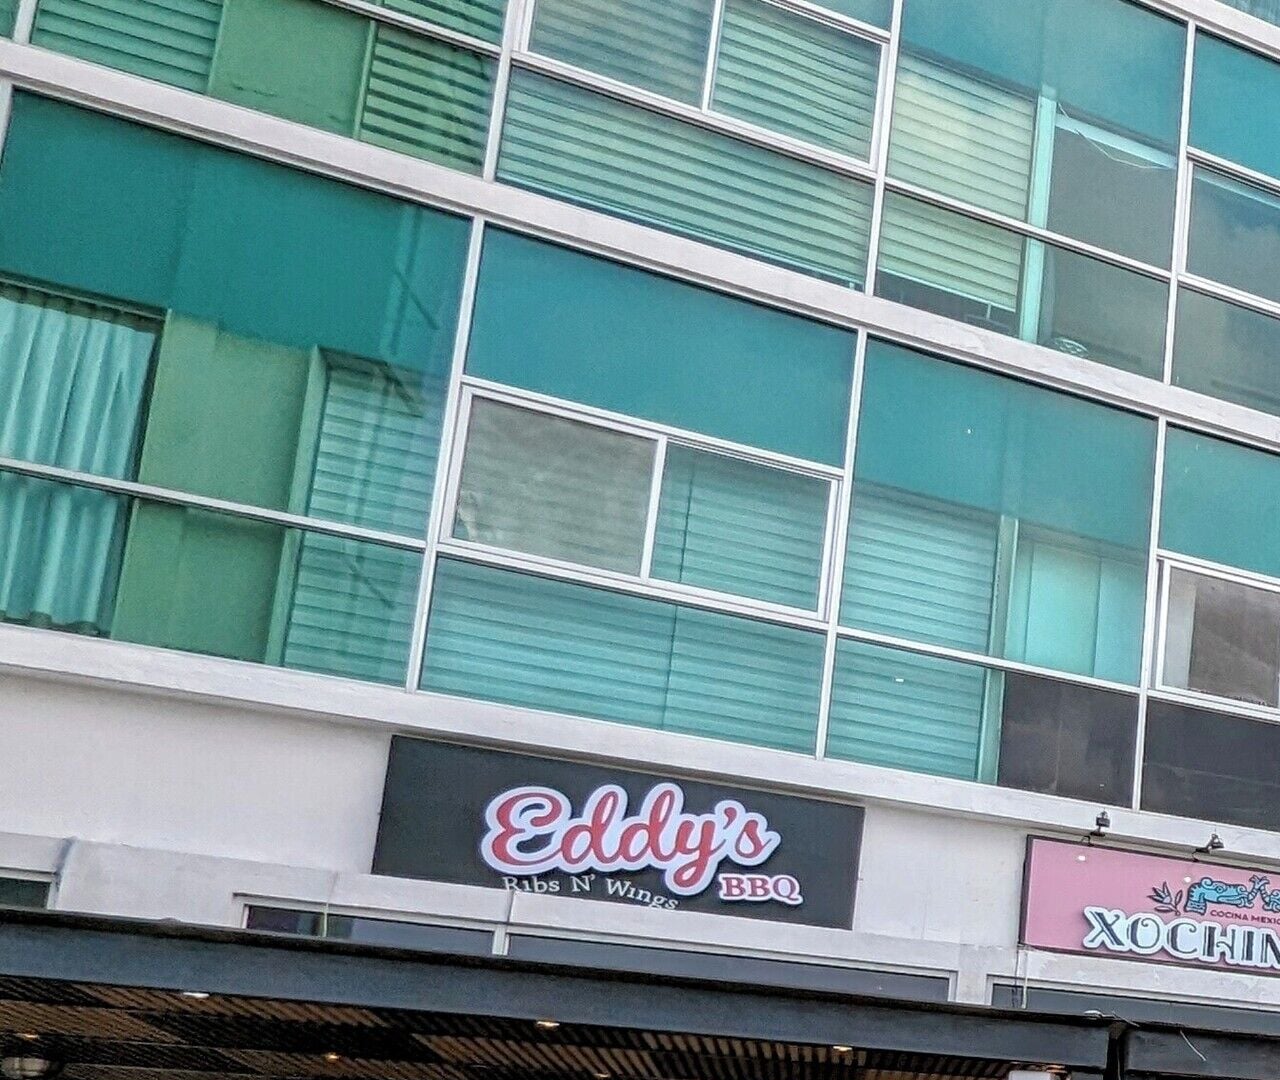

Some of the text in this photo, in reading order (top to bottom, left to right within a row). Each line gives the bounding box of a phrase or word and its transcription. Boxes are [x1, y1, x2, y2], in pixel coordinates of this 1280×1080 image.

[485, 785, 778, 894] Eddy's
[502, 876, 560, 893] Ribs
[605, 878, 679, 910] Wings
[719, 874, 802, 904] BBQ
[1210, 909, 1249, 921] COCINA
